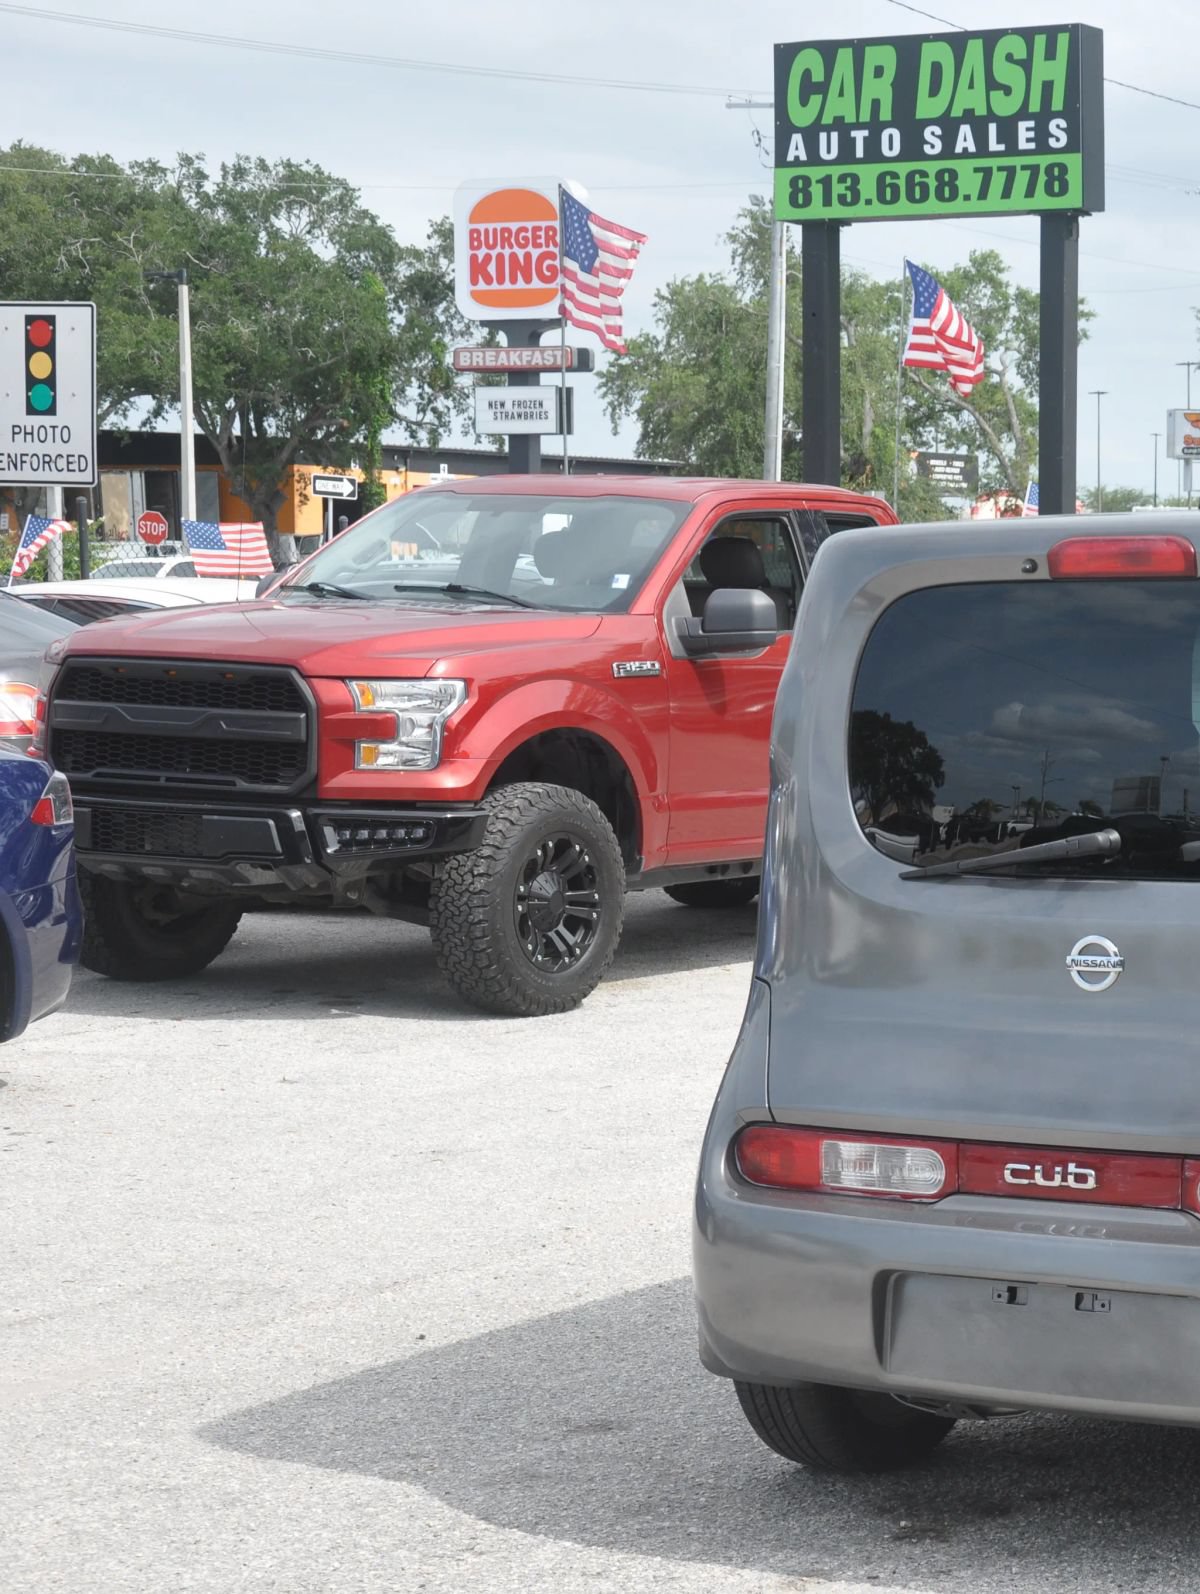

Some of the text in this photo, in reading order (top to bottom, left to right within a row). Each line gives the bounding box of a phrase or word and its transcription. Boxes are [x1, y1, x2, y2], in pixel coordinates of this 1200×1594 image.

[786, 31, 1071, 129] CAR DASH
[785, 117, 1069, 163] AUTO SALES
[787, 161, 1070, 210] 813.668.7778
[468, 224, 560, 252] BURGER
[468, 251, 560, 287] KING
[458, 350, 564, 367] BREAKFAST
[487, 399, 544, 410] NEW FROZEN
[493, 410, 550, 421] STRAWBRIES
[11, 424, 72, 445] PHOTO
[139, 520, 166, 536] STOP
[1070, 958, 1116, 969] NISSAN
[1003, 1162, 1097, 1190] cub
